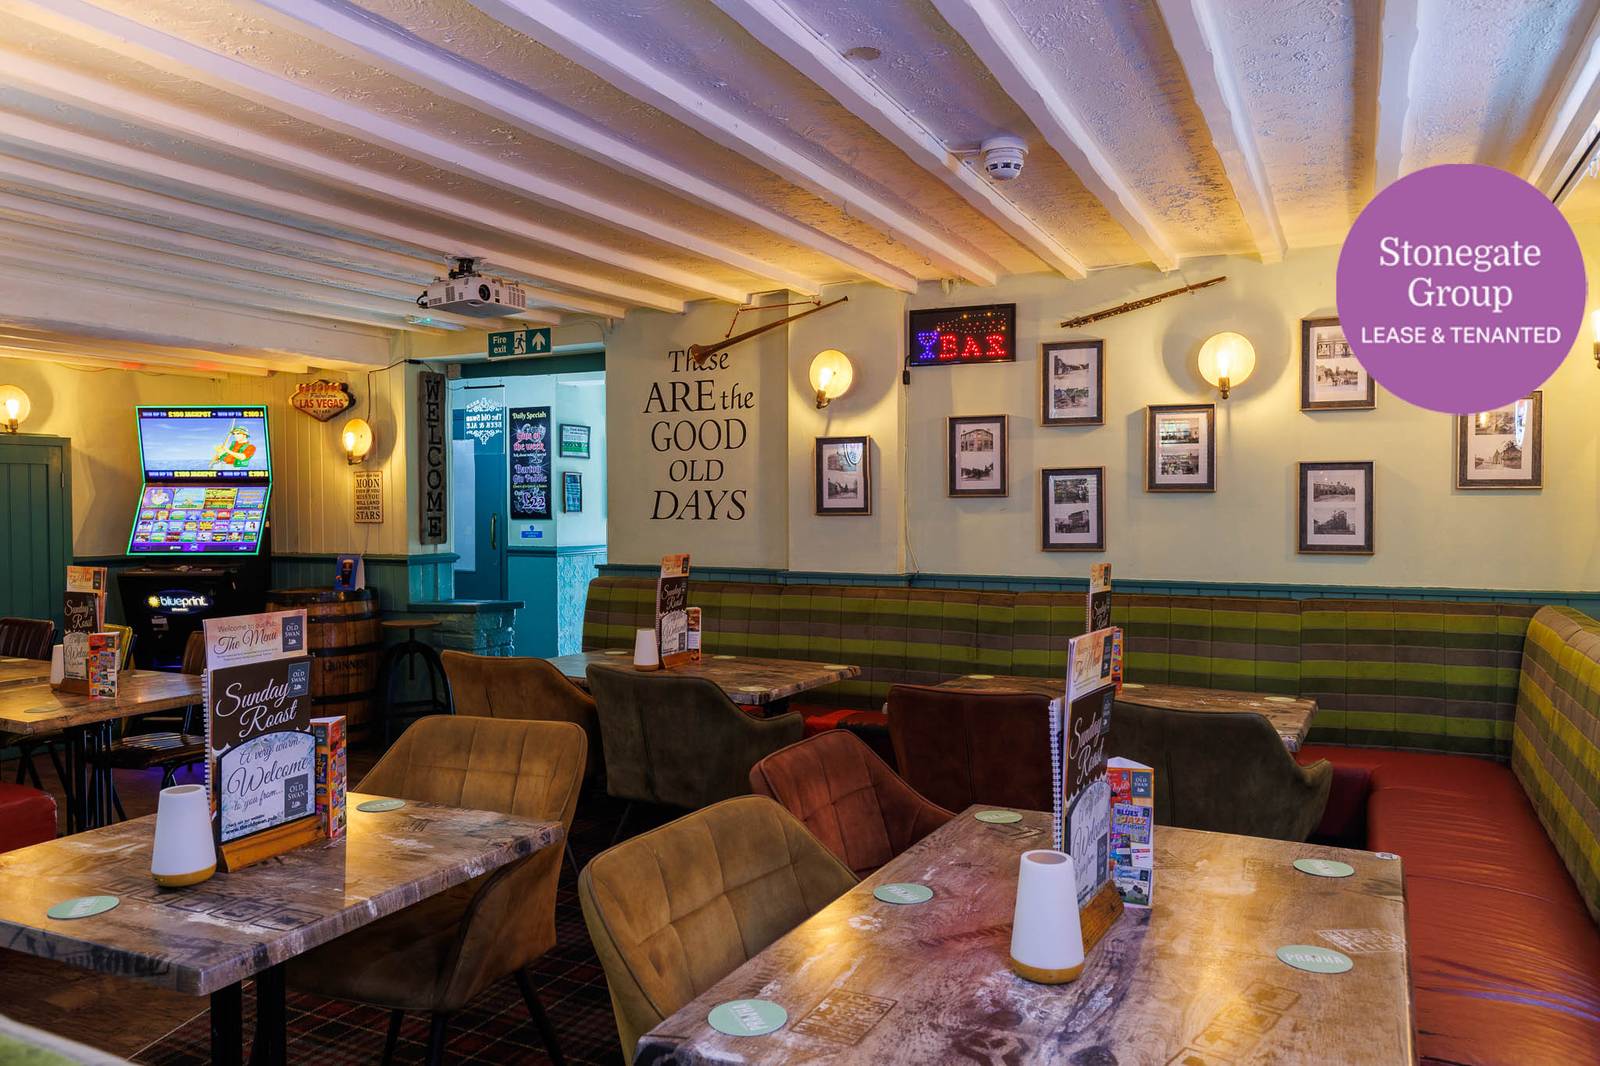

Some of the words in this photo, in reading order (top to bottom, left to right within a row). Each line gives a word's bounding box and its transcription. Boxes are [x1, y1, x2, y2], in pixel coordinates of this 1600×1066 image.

[493, 336, 506, 344] Fire
[494, 345, 506, 353] exit
[939, 334, 1006, 358] BAR
[300, 399, 313, 408] LAS
[316, 399, 344, 408] VEGAS
[643, 380, 716, 413] ARE
[720, 382, 755, 410] the
[512, 412, 526, 420] Daily
[527, 411, 547, 420] Specials
[651, 419, 747, 452] GOOD
[425, 379, 443, 537] WELCOME
[669, 459, 724, 482] OLD
[356, 479, 380, 488] MOON
[522, 491, 545, 510] £22
[650, 490, 747, 521] DAYS
[356, 511, 380, 520] STARS
[64, 599, 89, 617] Sunday
[160, 596, 208, 607] blueprint
[72, 613, 93, 629] Roast
[214, 636, 240, 655] The
[243, 629, 278, 647] Menu
[215, 678, 290, 717] Sunday
[239, 699, 298, 738] Roast
[1070, 712, 1102, 759] Sunday
[254, 747, 272, 762] very
[275, 737, 300, 752] warm
[1077, 737, 1104, 785] Roast
[227, 758, 308, 797] Welcome
[288, 791, 305, 801] SWAN
[289, 783, 304, 792] OLD
[242, 795, 258, 812] you
[1126, 816, 1146, 825] JAZZ
